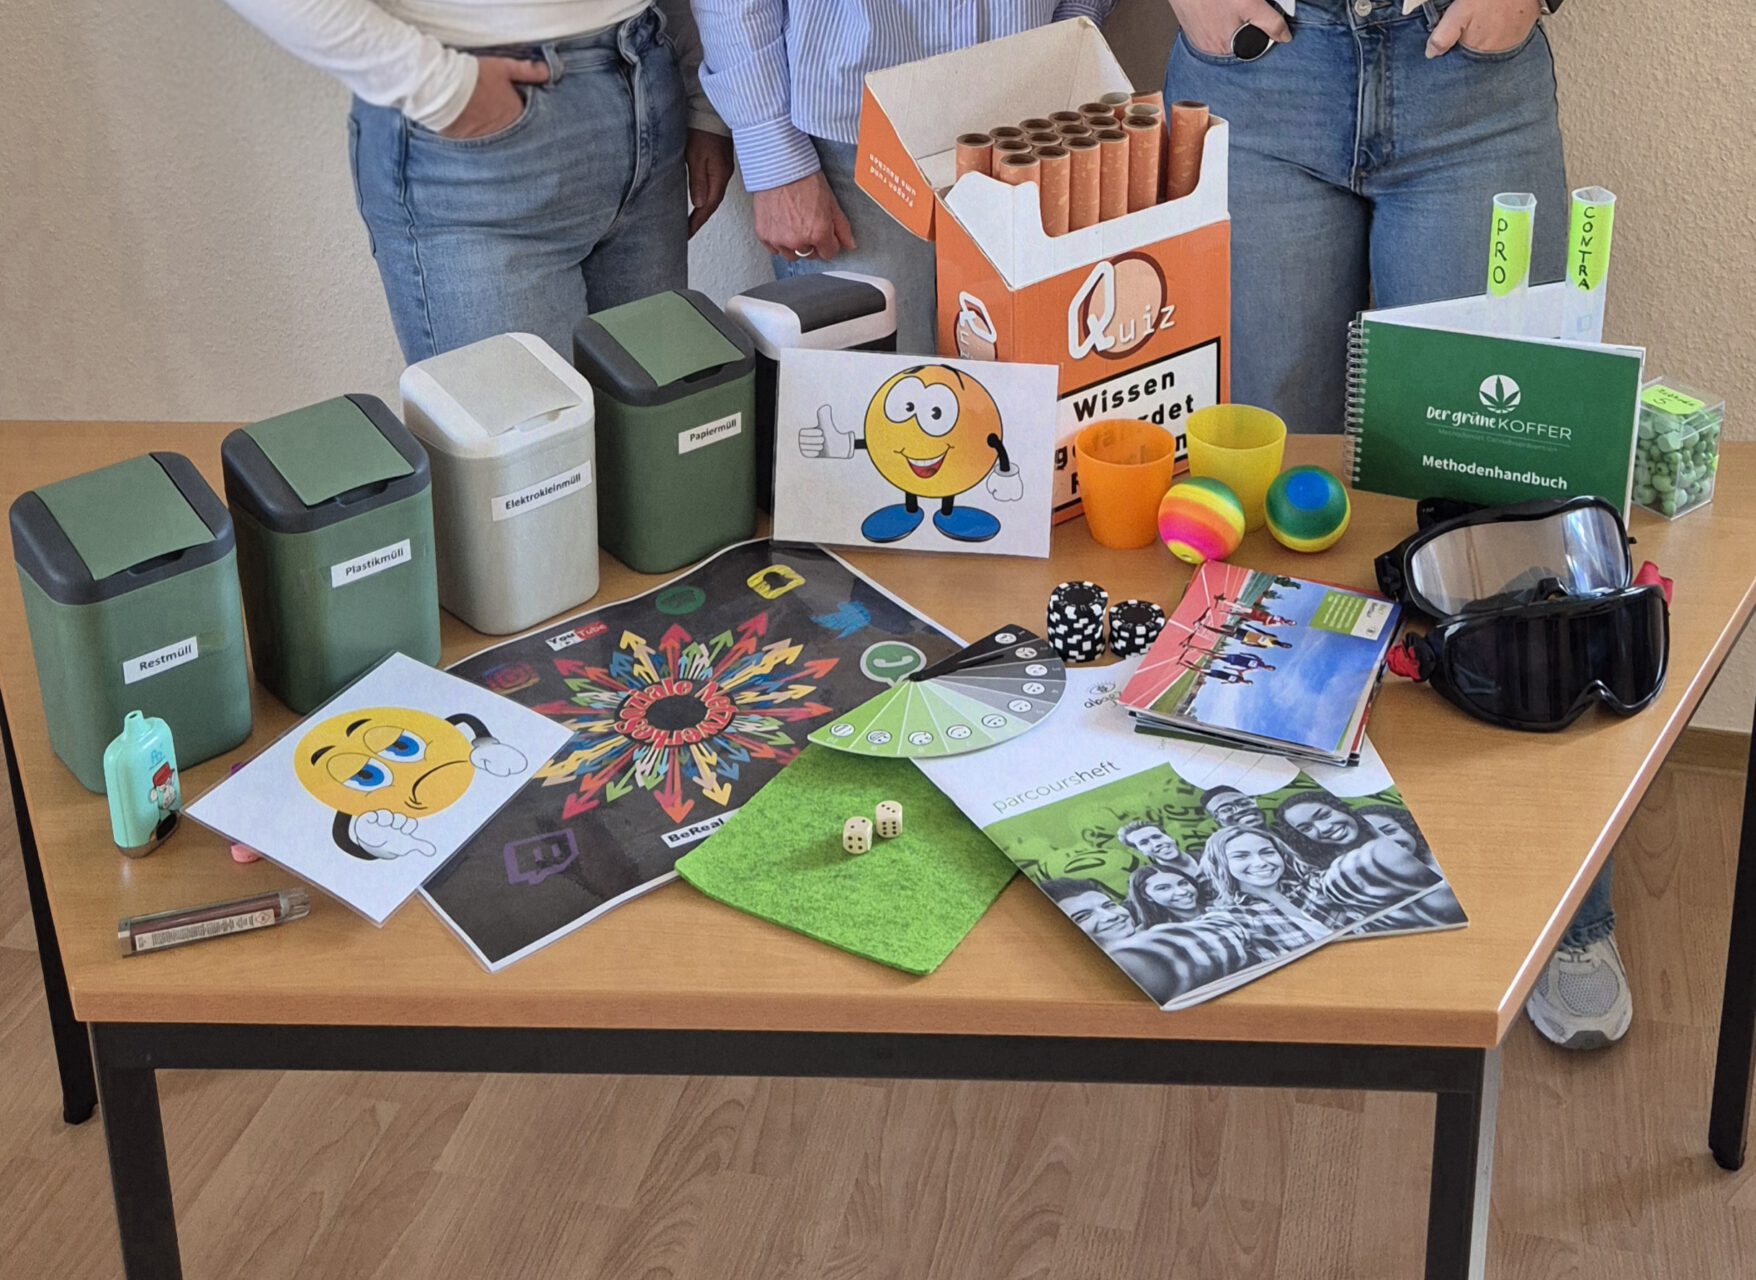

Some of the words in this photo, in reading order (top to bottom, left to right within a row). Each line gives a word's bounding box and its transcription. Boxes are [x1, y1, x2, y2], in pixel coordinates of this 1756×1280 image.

[1492, 217, 1509, 285] PRO
[1577, 206, 1596, 291] CONTRA
[1067, 260, 1176, 360] Quiz
[1072, 371, 1176, 423] Wissen
[689, 418, 737, 443] Papiermüll
[1426, 405, 1451, 421] Der
[1452, 410, 1497, 427] grüne
[1498, 417, 1573, 441] KOFFER
[504, 472, 582, 511] Elektrokleinmüll
[1421, 454, 1568, 490] Methodenhandbuch
[345, 547, 404, 577] Plastikmüll
[139, 643, 192, 672] Restmüll
[613, 677, 693, 735] Soziale
[991, 760, 1122, 815] parcoursheft
[667, 817, 725, 843] BeReal
